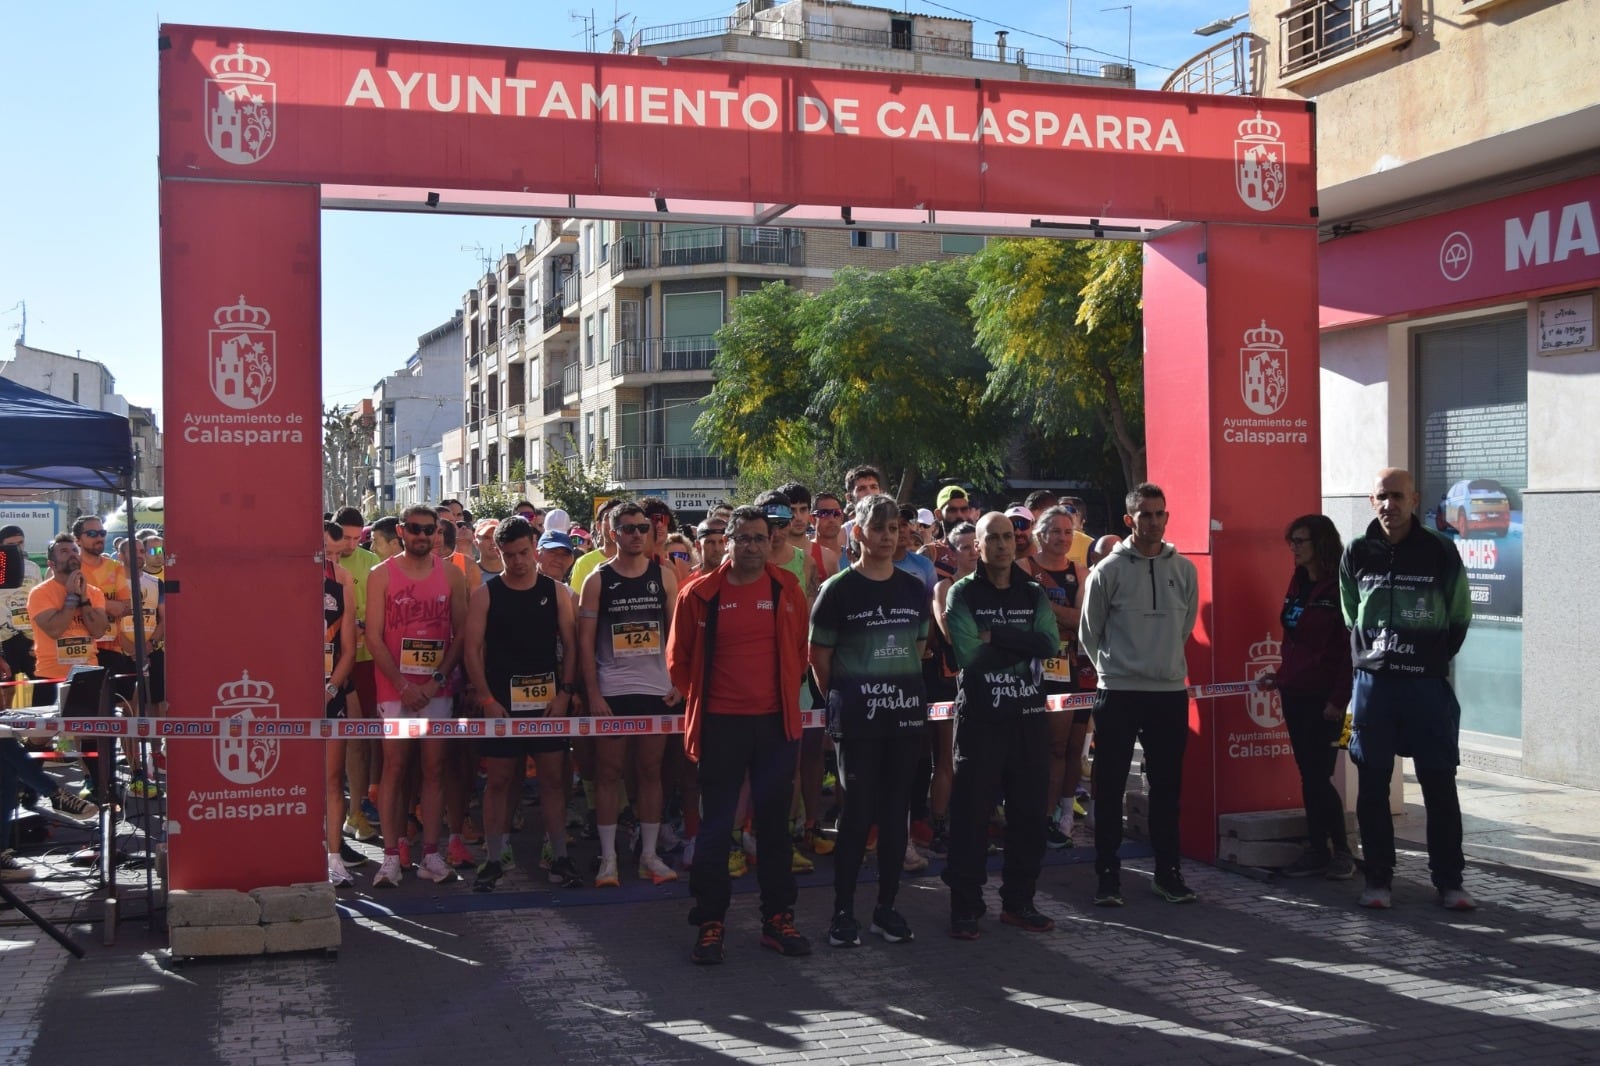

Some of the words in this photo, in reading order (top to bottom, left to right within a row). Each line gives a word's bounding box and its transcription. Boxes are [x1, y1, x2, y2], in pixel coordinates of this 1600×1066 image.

[344, 68, 779, 130] AYUNTAMIENTO
[797, 95, 860, 135] DE
[876, 101, 1186, 153] CALASPARRA
[183, 412, 282, 425] Ayuntamiento
[285, 412, 303, 424] de
[1223, 417, 1292, 428] Ayuntamiento
[1294, 417, 1308, 427] de
[183, 426, 303, 447] Calasparra
[1223, 428, 1308, 446] Calasparra
[675, 499, 704, 511] gran
[624, 631, 651, 646] 124
[66, 645, 88, 656] 085
[873, 647, 909, 658] astrac
[412, 651, 437, 663] 153
[522, 685, 548, 699] 169
[861, 682, 897, 695] new
[867, 688, 920, 720] garden
[1065, 694, 1095, 706] FAM
[71, 721, 121, 732] FAMU
[162, 722, 213, 734] FAMU
[254, 723, 304, 735] FAMU
[344, 722, 393, 735] FAMU
[431, 722, 480, 734] FAMU
[519, 722, 565, 733] FAMU
[601, 720, 646, 732] FAMU
[187, 786, 286, 803] Ayuntamiento
[288, 784, 307, 797] de
[187, 800, 307, 821] Calasparra
